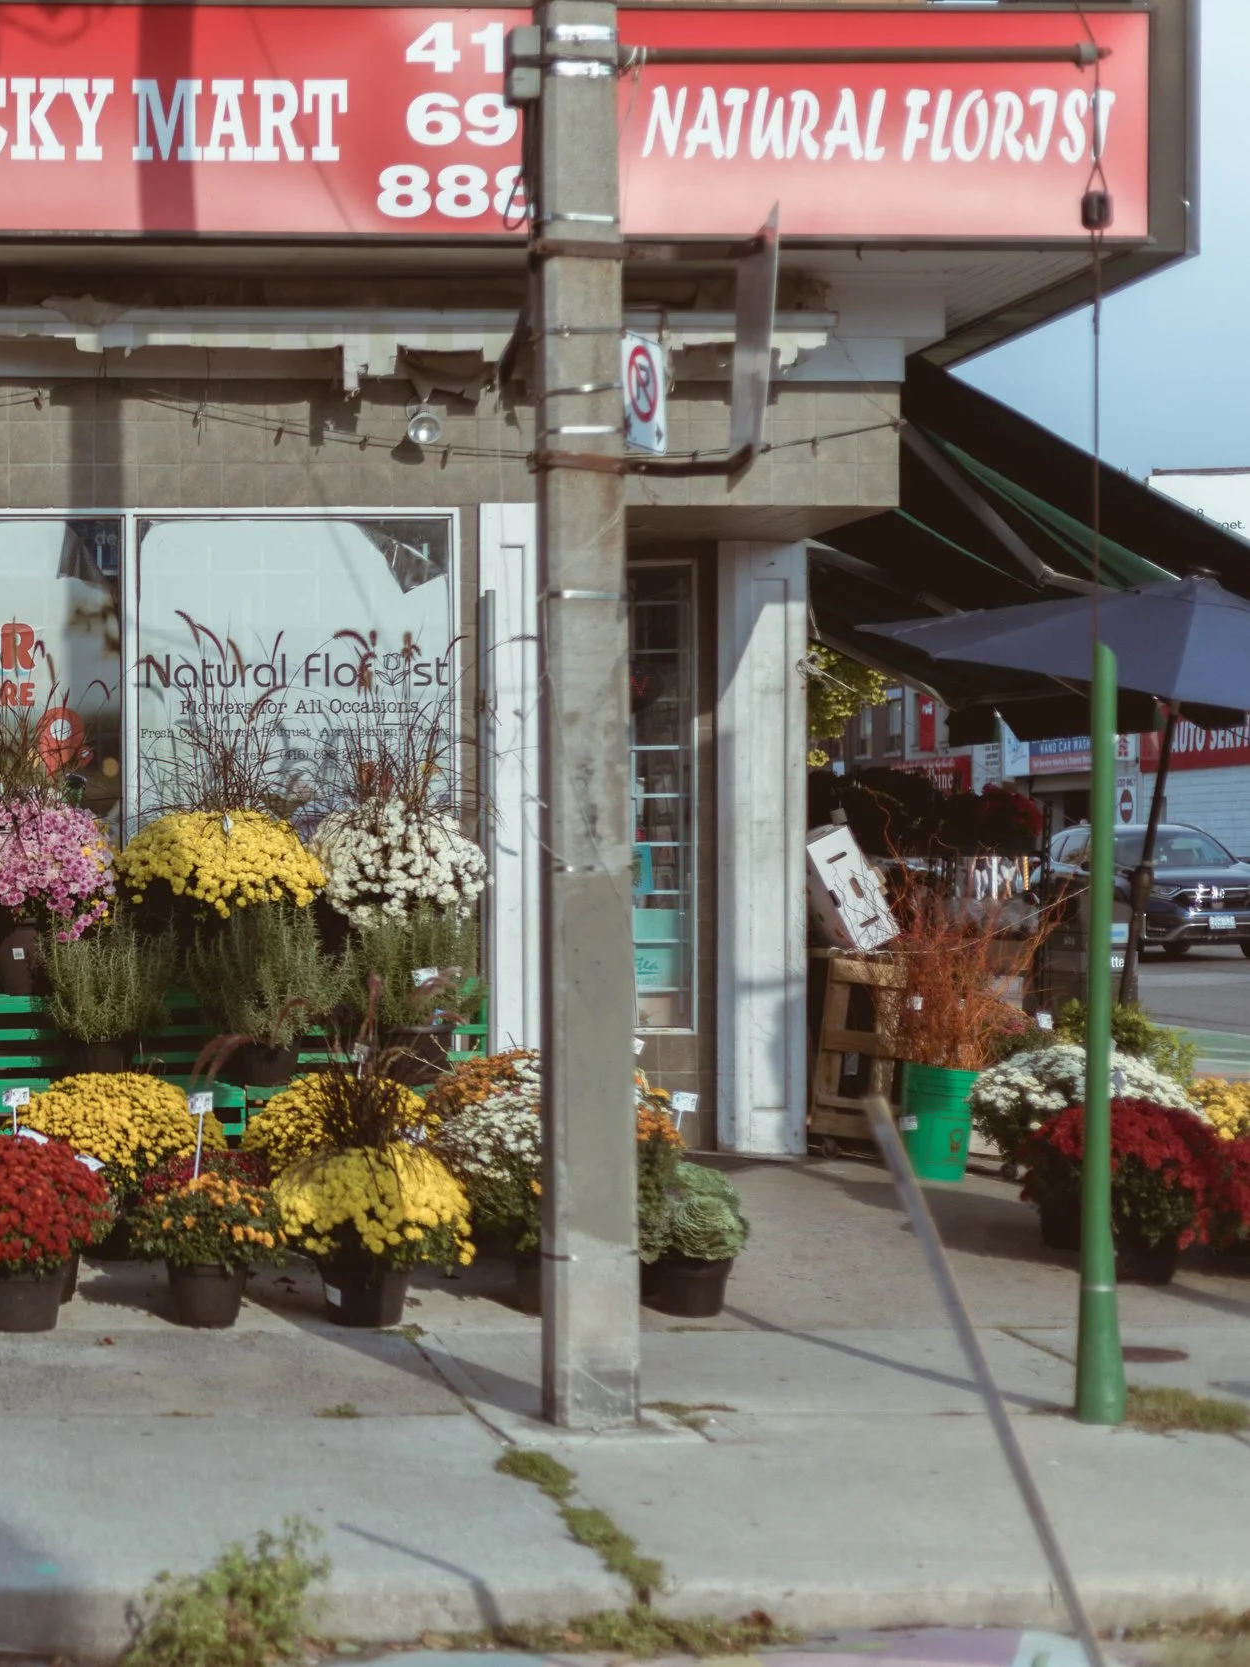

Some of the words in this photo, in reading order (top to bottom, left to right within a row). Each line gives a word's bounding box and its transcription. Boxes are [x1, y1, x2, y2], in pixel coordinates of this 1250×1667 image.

[132, 79, 348, 161] MART
[642, 86, 887, 162] NATURAL
[902, 89, 1116, 163] FLORIST
[145, 653, 287, 688] Natural
[179, 699, 253, 715] Flowers
[258, 699, 288, 715] for
[294, 700, 324, 714] All
[329, 698, 419, 714] Occasions
[140, 728, 174, 739] Fresh
[1058, 741, 1071, 752] CAR
